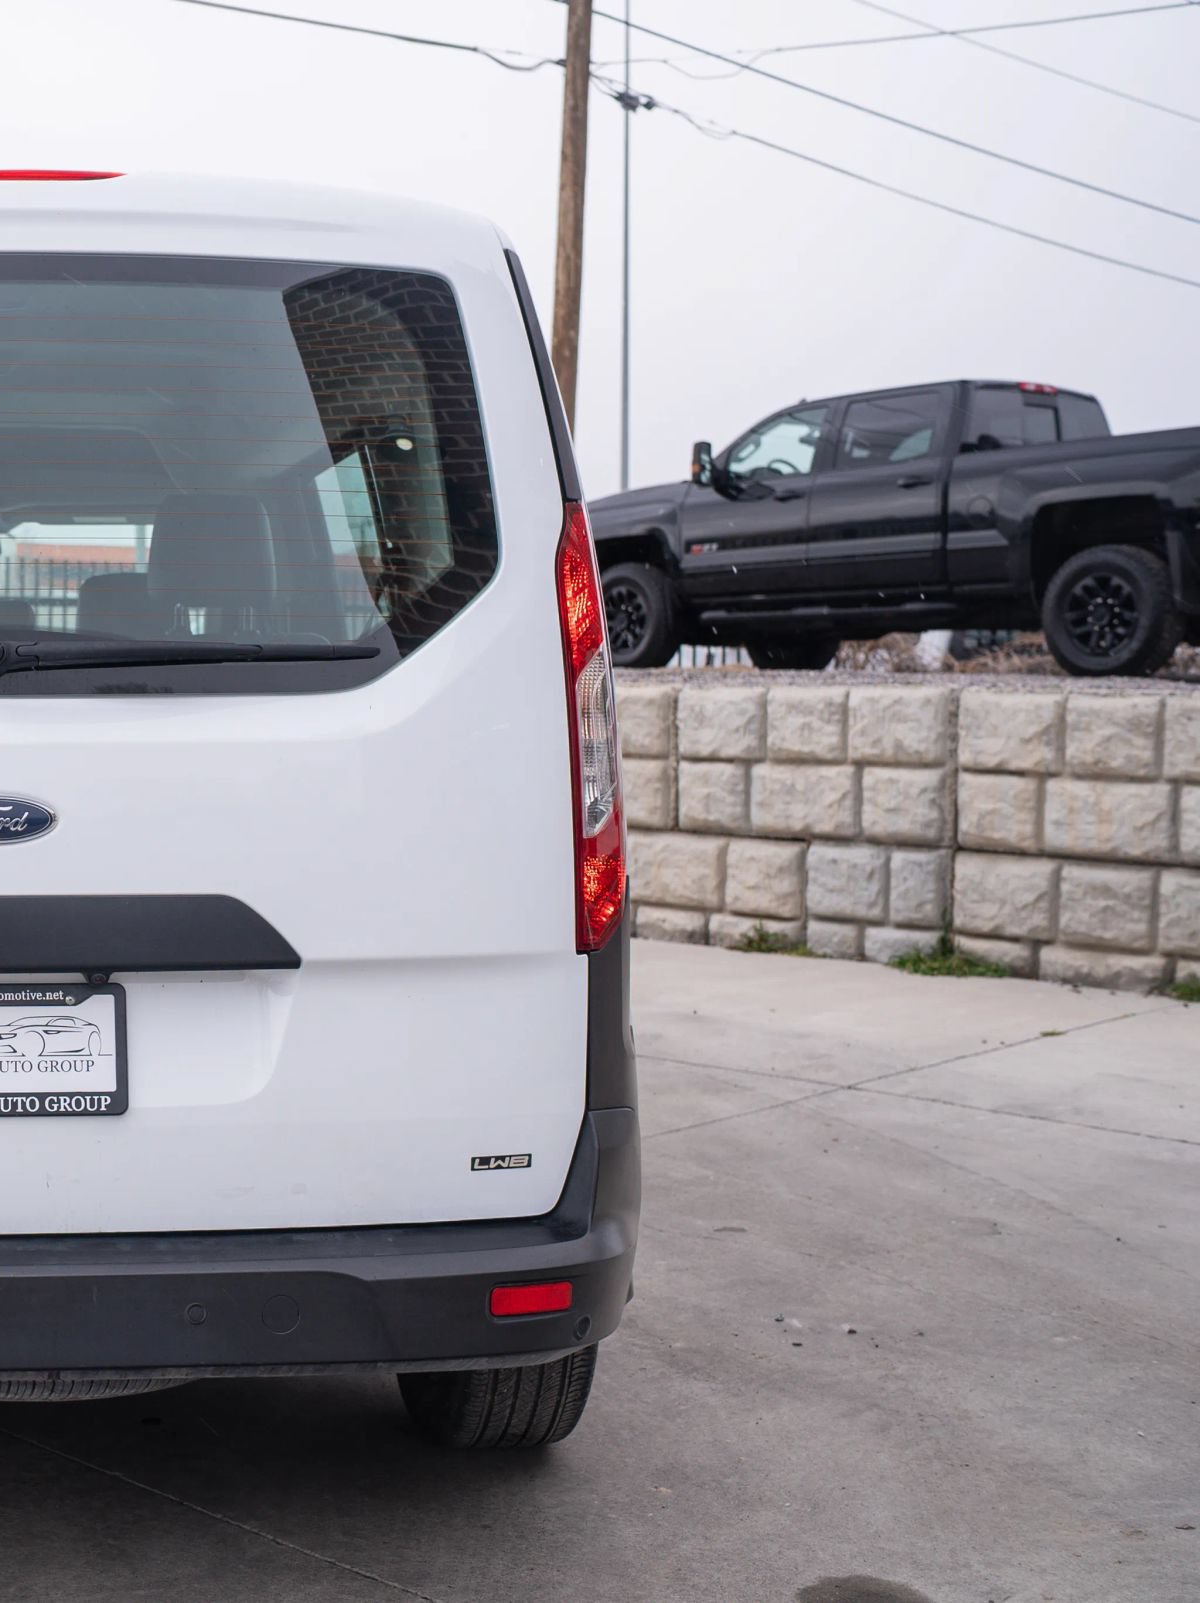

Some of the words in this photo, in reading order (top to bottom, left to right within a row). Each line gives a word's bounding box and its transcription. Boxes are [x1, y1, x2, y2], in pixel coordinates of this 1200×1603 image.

[37, 1060, 95, 1073] GROUP
[44, 1095, 112, 1112] GROUP
[473, 1155, 530, 1169] LWB
